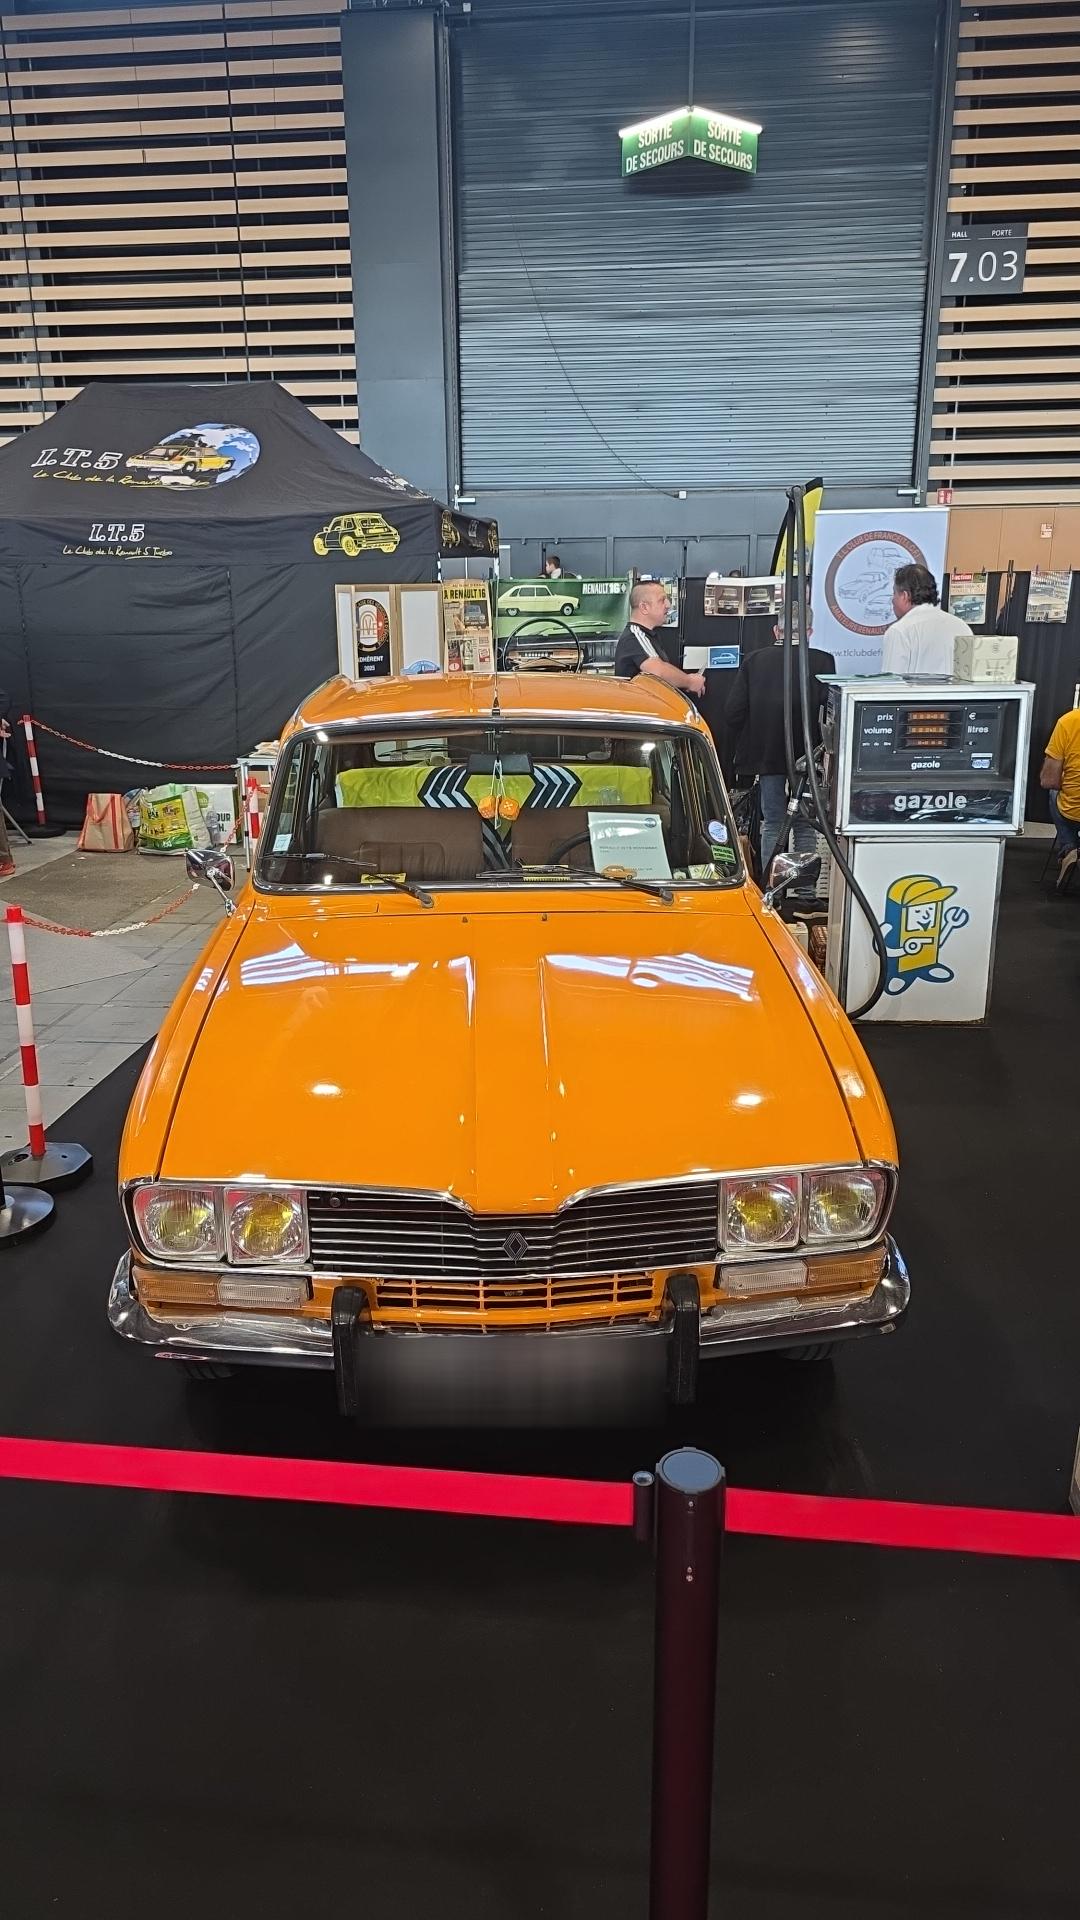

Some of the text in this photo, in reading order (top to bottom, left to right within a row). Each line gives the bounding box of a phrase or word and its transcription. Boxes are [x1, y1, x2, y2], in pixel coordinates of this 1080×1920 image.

[638, 121, 672, 148] SORTIE
[708, 121, 742, 146] SORTIE
[626, 140, 684, 173] DE SECOURS
[694, 139, 752, 170] DE SECOURS
[991, 229, 1013, 237] PORTE
[949, 250, 1018, 283] 7.03
[53, 471, 81, 482] Club
[85, 473, 103, 482] de
[847, 534, 864, 550] CLUB
[864, 531, 873, 541] DE
[873, 530, 901, 541] FRANCE
[75, 545, 93, 555] Club
[95, 546, 106, 555] de
[107, 546, 114, 555] la
[115, 545, 141, 556] Renault
[153, 546, 173, 556] Turbo
[450, 589, 478, 600] RENAULT
[478, 588, 486, 598] 16
[582, 582, 620, 595] RENAULT 16
[877, 713, 894, 722] prix
[968, 712, 976, 720] €
[864, 726, 893, 734] volume
[967, 726, 989, 734] litres
[911, 760, 940, 770] gazole
[894, 792, 967, 812] gazole
